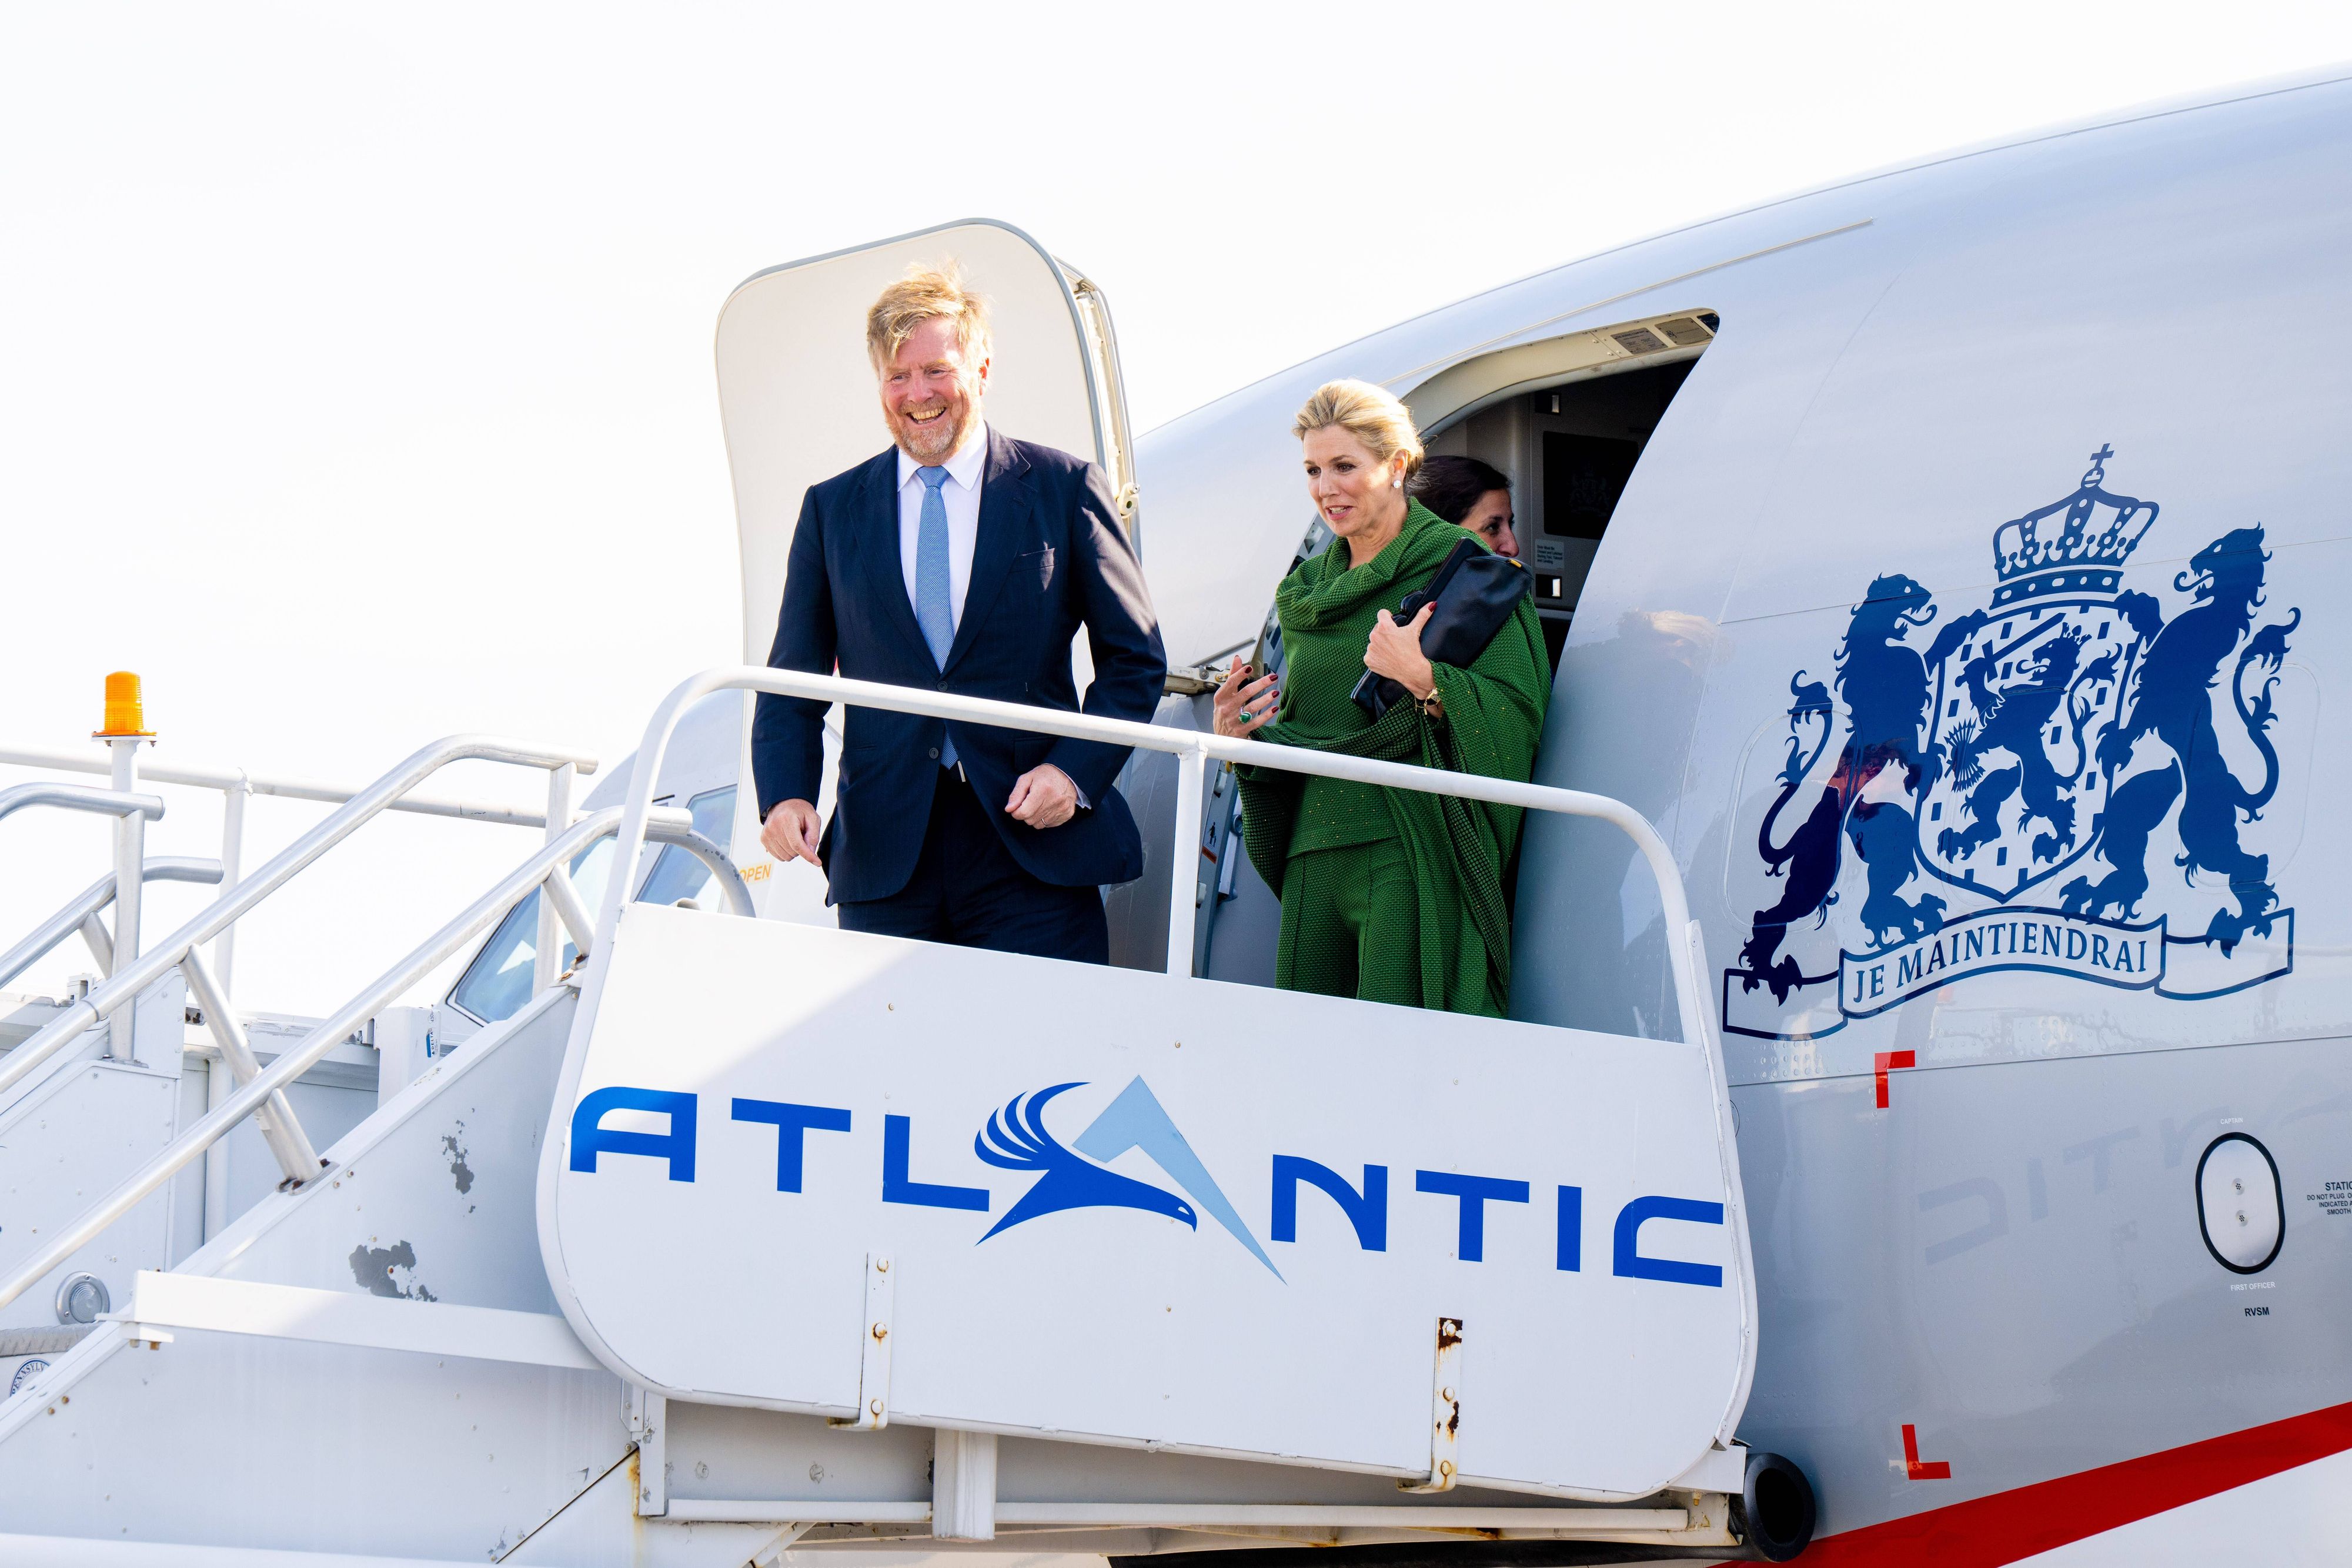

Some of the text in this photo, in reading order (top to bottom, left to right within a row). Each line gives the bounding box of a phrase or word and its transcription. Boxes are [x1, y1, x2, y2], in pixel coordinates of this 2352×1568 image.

[1853, 922, 2147, 1002] JE MAINTIENDRAI
[569, 1075, 1724, 1288] ATLANTIC
[2249, 1281, 2276, 1290] OFFICER
[2244, 1306, 2270, 1316] RVSM
[12, 1362, 46, 1395] PENNSYLV
